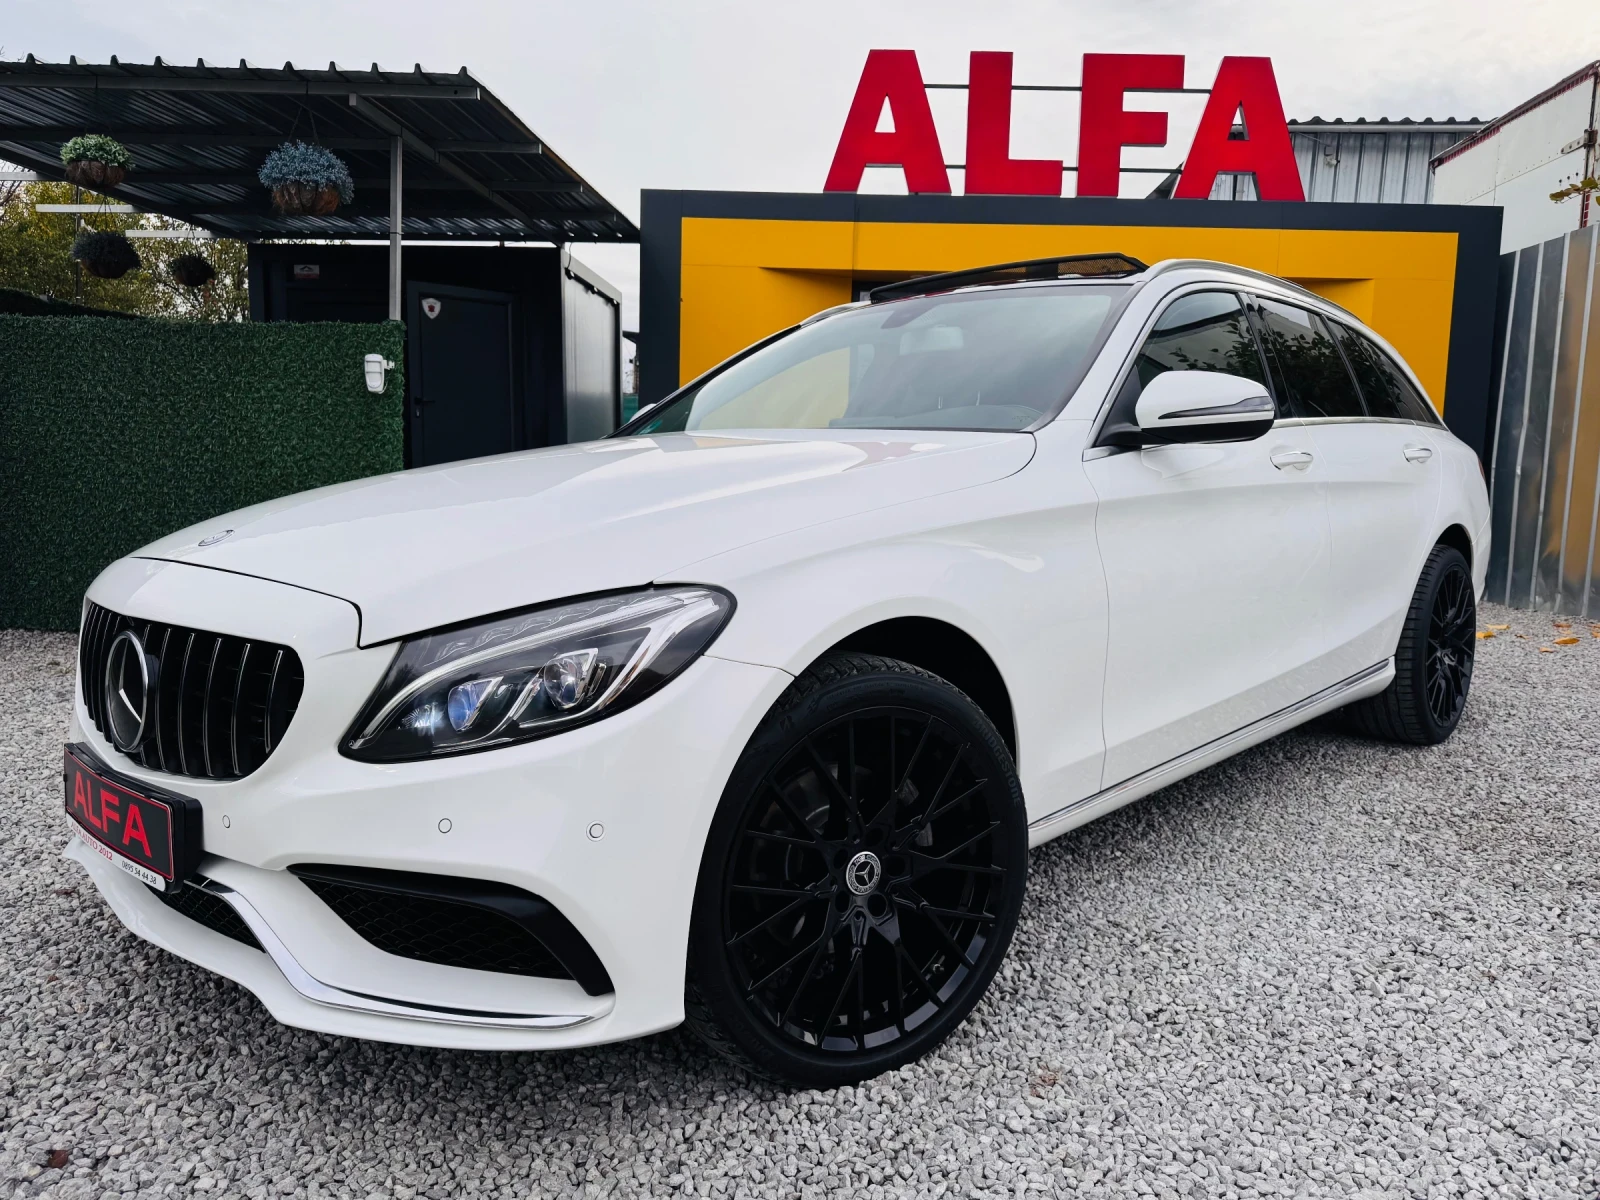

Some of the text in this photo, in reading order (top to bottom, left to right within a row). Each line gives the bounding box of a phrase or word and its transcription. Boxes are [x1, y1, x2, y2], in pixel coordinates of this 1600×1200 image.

[824, 49, 1305, 201] ALFA
[74, 770, 152, 858] ALFA
[98, 844, 113, 861] 2012
[121, 860, 157, 885] 0895 54 44 38
